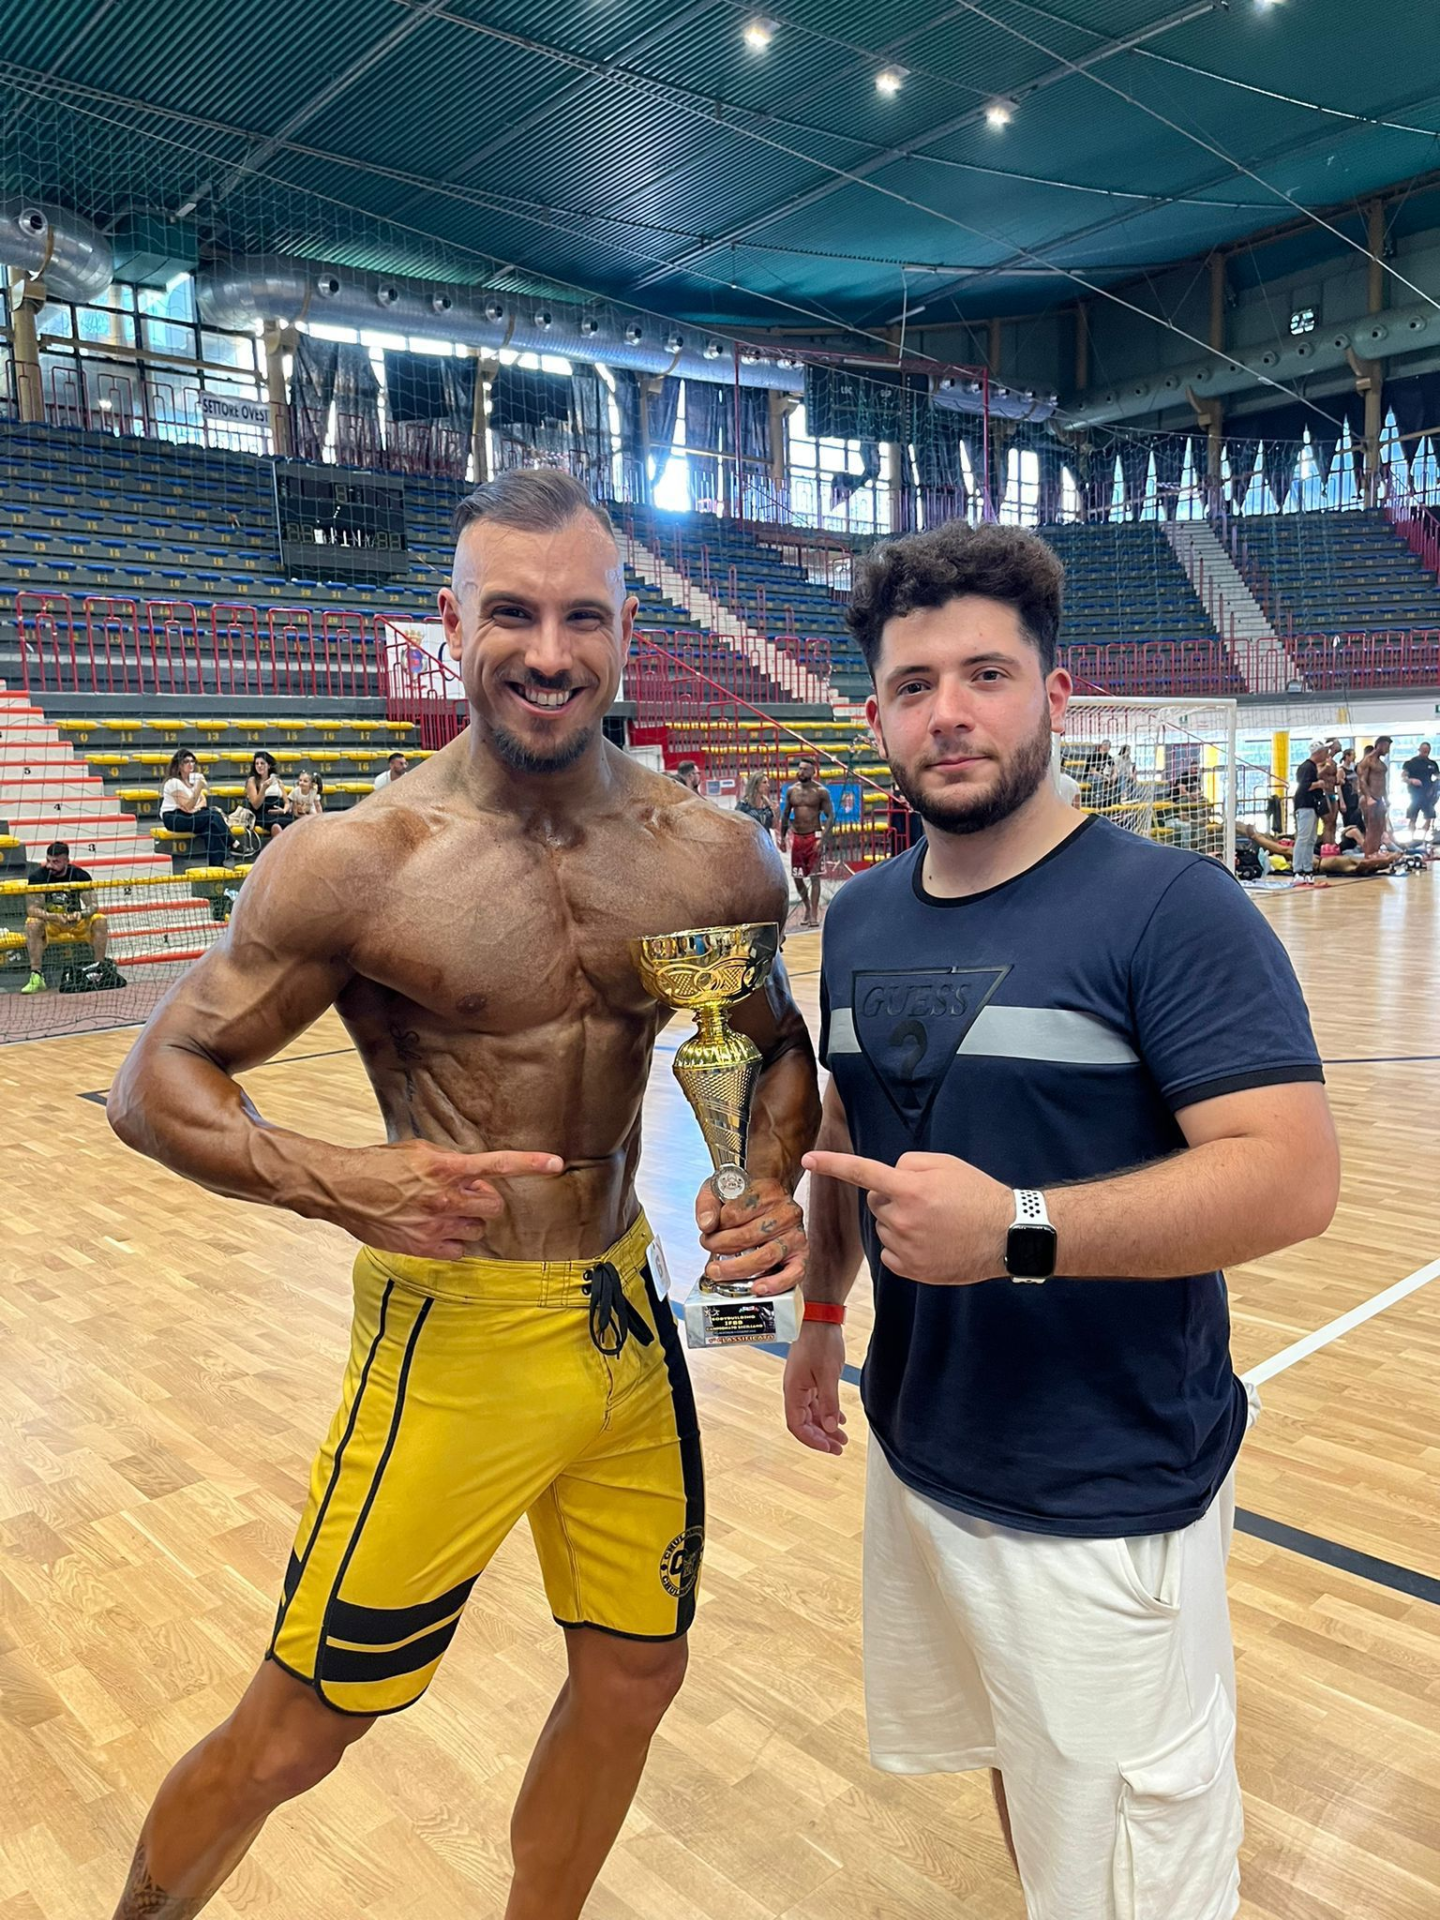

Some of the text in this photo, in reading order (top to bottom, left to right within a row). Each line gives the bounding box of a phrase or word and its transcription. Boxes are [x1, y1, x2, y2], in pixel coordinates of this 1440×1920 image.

[203, 398, 269, 423] SETTORE OVEST
[75, 733, 89, 743] 0
[24, 767, 31, 775] 5
[53, 803, 62, 811] 4
[88, 844, 96, 852] 3
[862, 983, 971, 1018] GUESS
